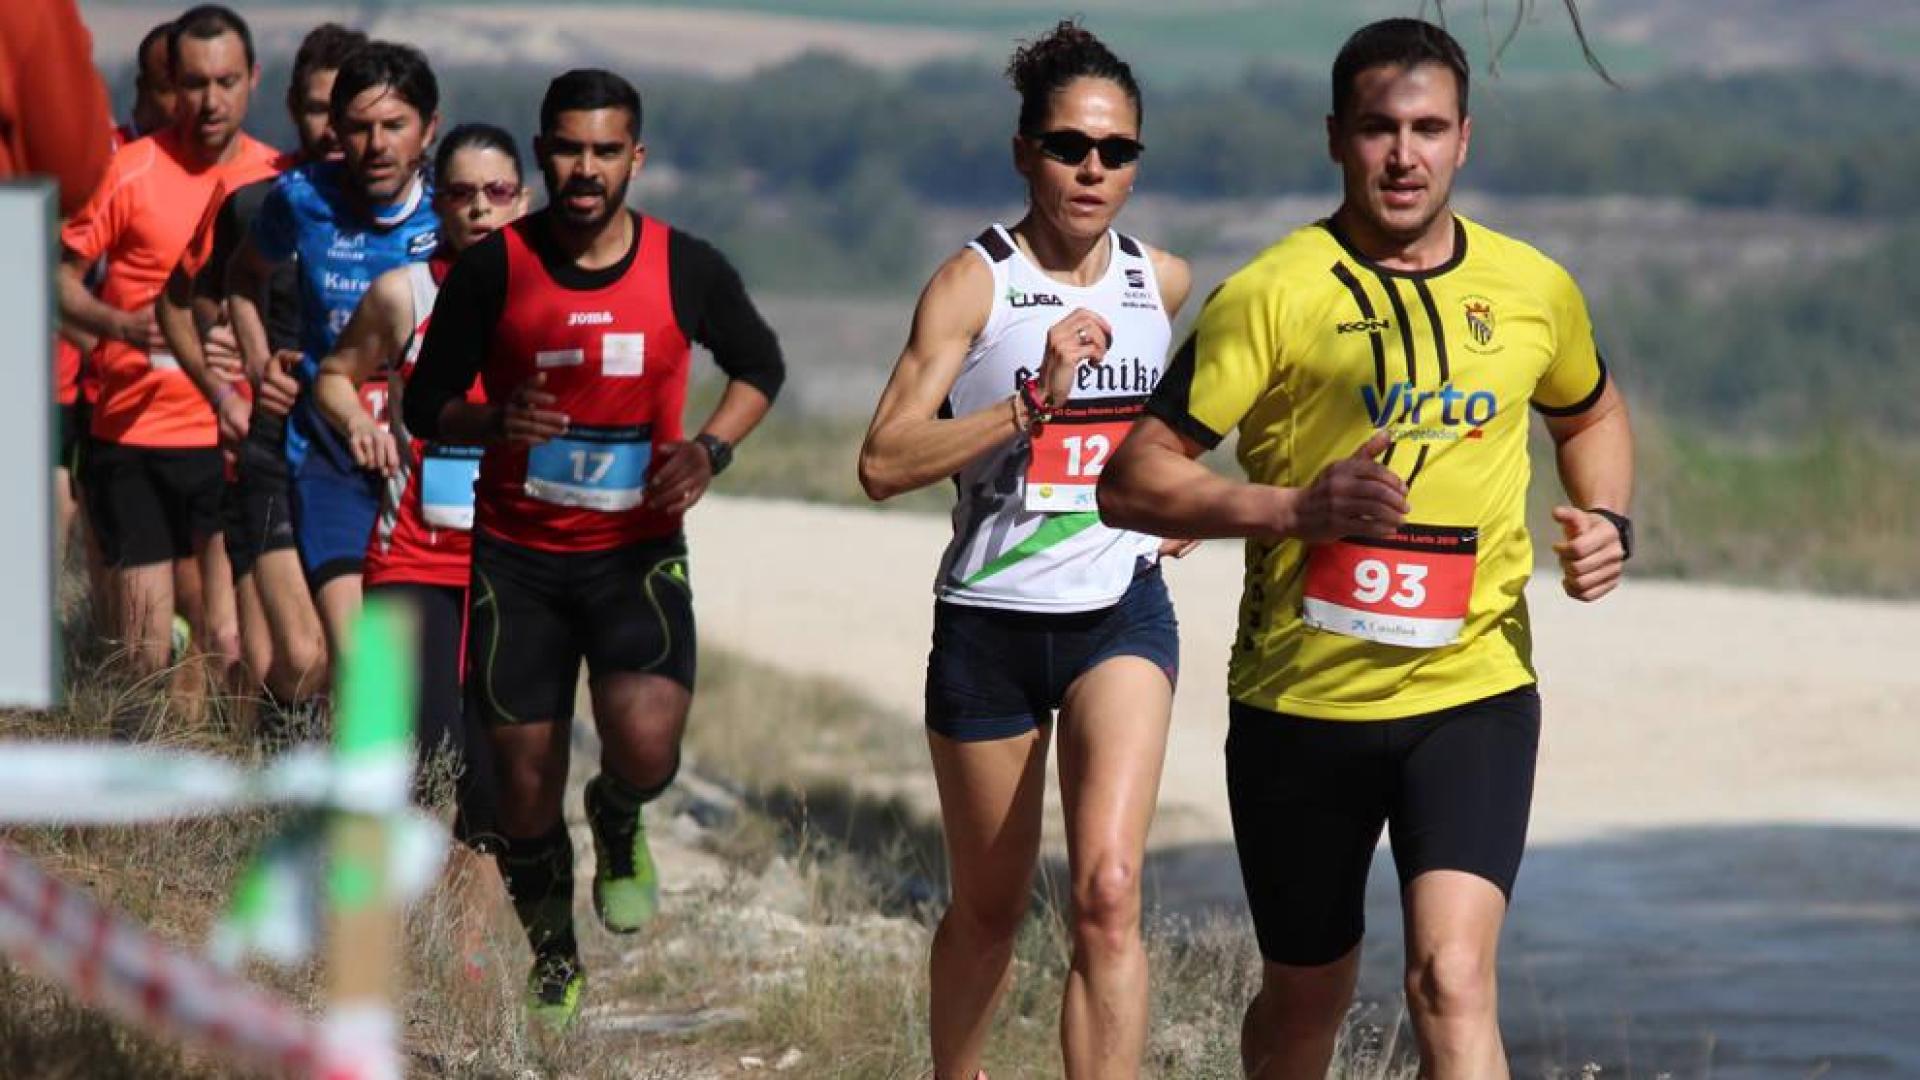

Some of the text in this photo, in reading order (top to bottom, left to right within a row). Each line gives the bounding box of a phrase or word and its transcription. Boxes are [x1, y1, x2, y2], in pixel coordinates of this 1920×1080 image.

[1360, 382, 1498, 428] Virto
[570, 450, 615, 483] 17
[1062, 434, 1111, 476] 12
[1353, 559, 1428, 609] 93
